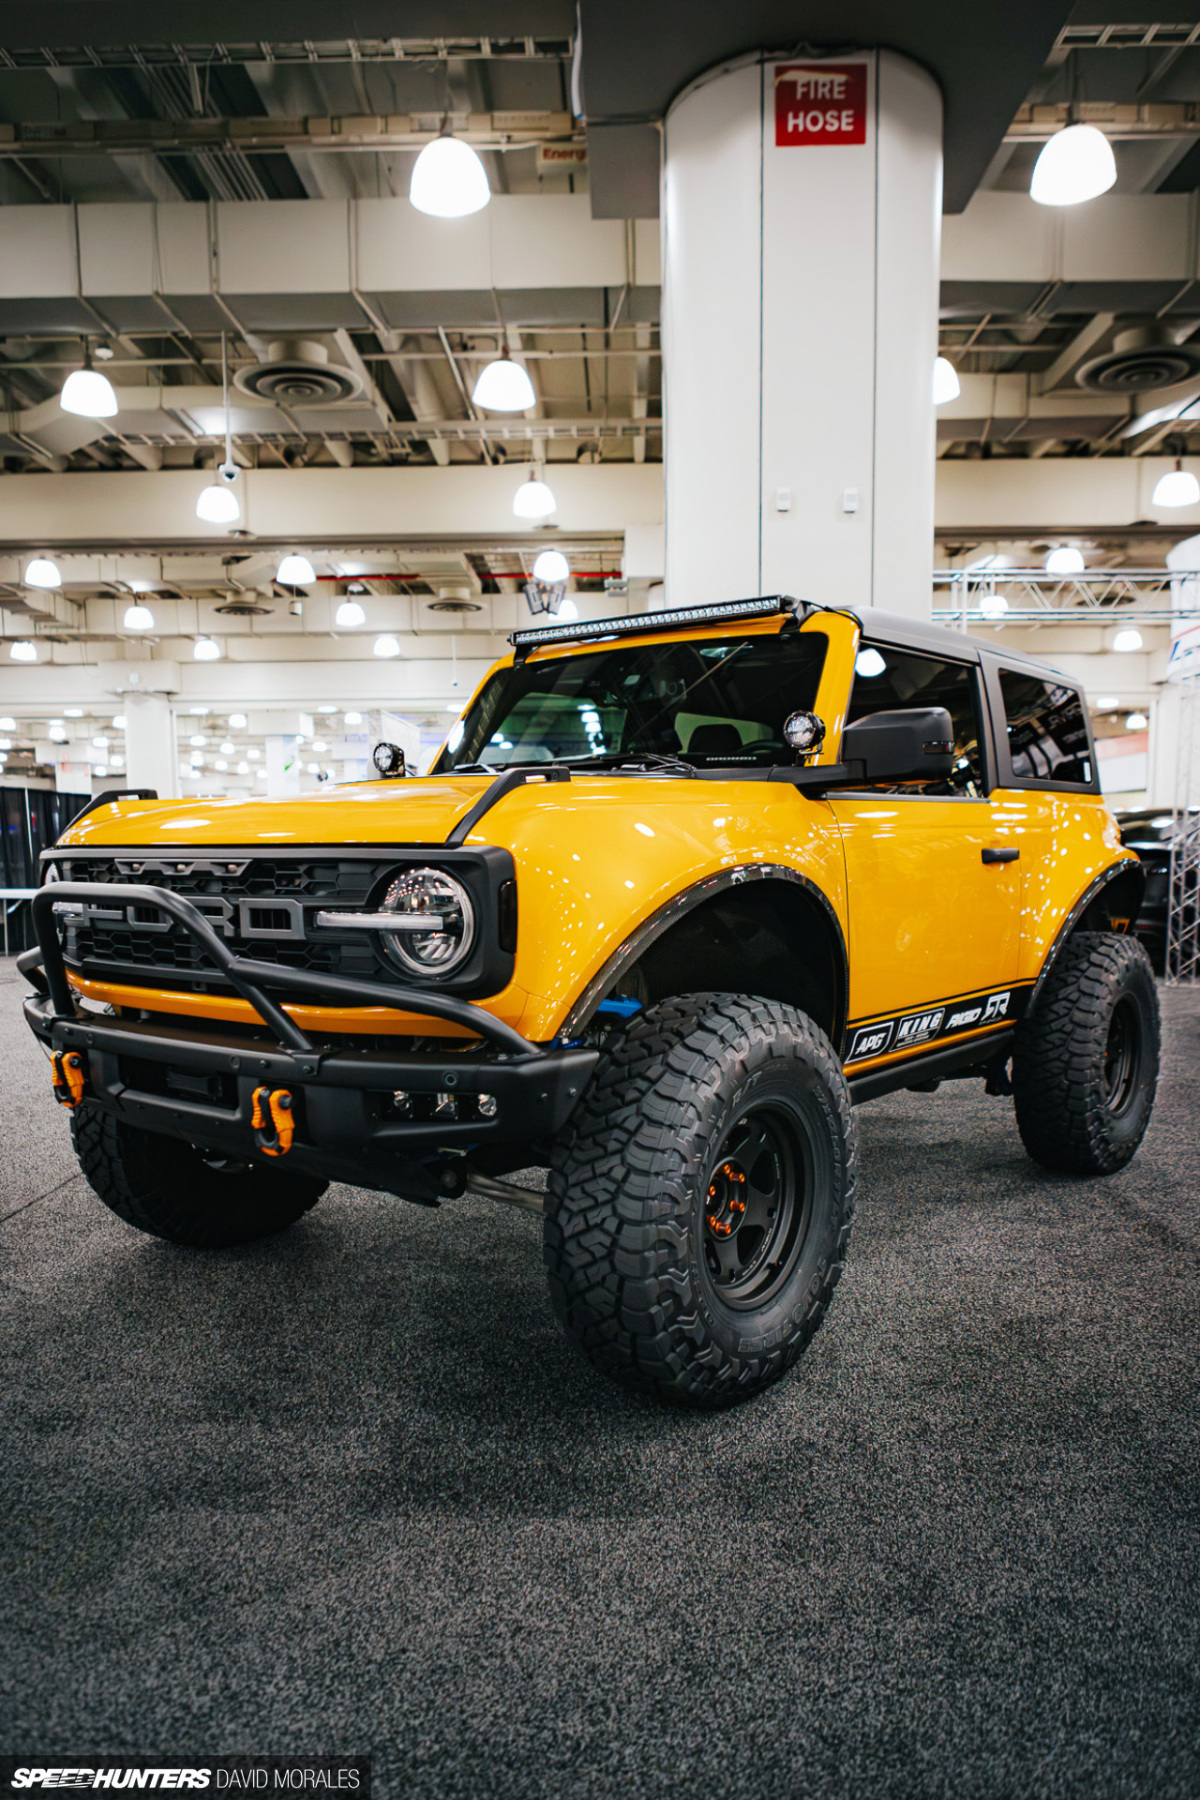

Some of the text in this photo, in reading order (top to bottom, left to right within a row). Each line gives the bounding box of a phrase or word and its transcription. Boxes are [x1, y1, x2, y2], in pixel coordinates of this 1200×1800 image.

[796, 78, 847, 100] FIRE
[787, 110, 854, 133] HOSE
[898, 1012, 943, 1037] KING
[854, 1032, 887, 1055] APG
